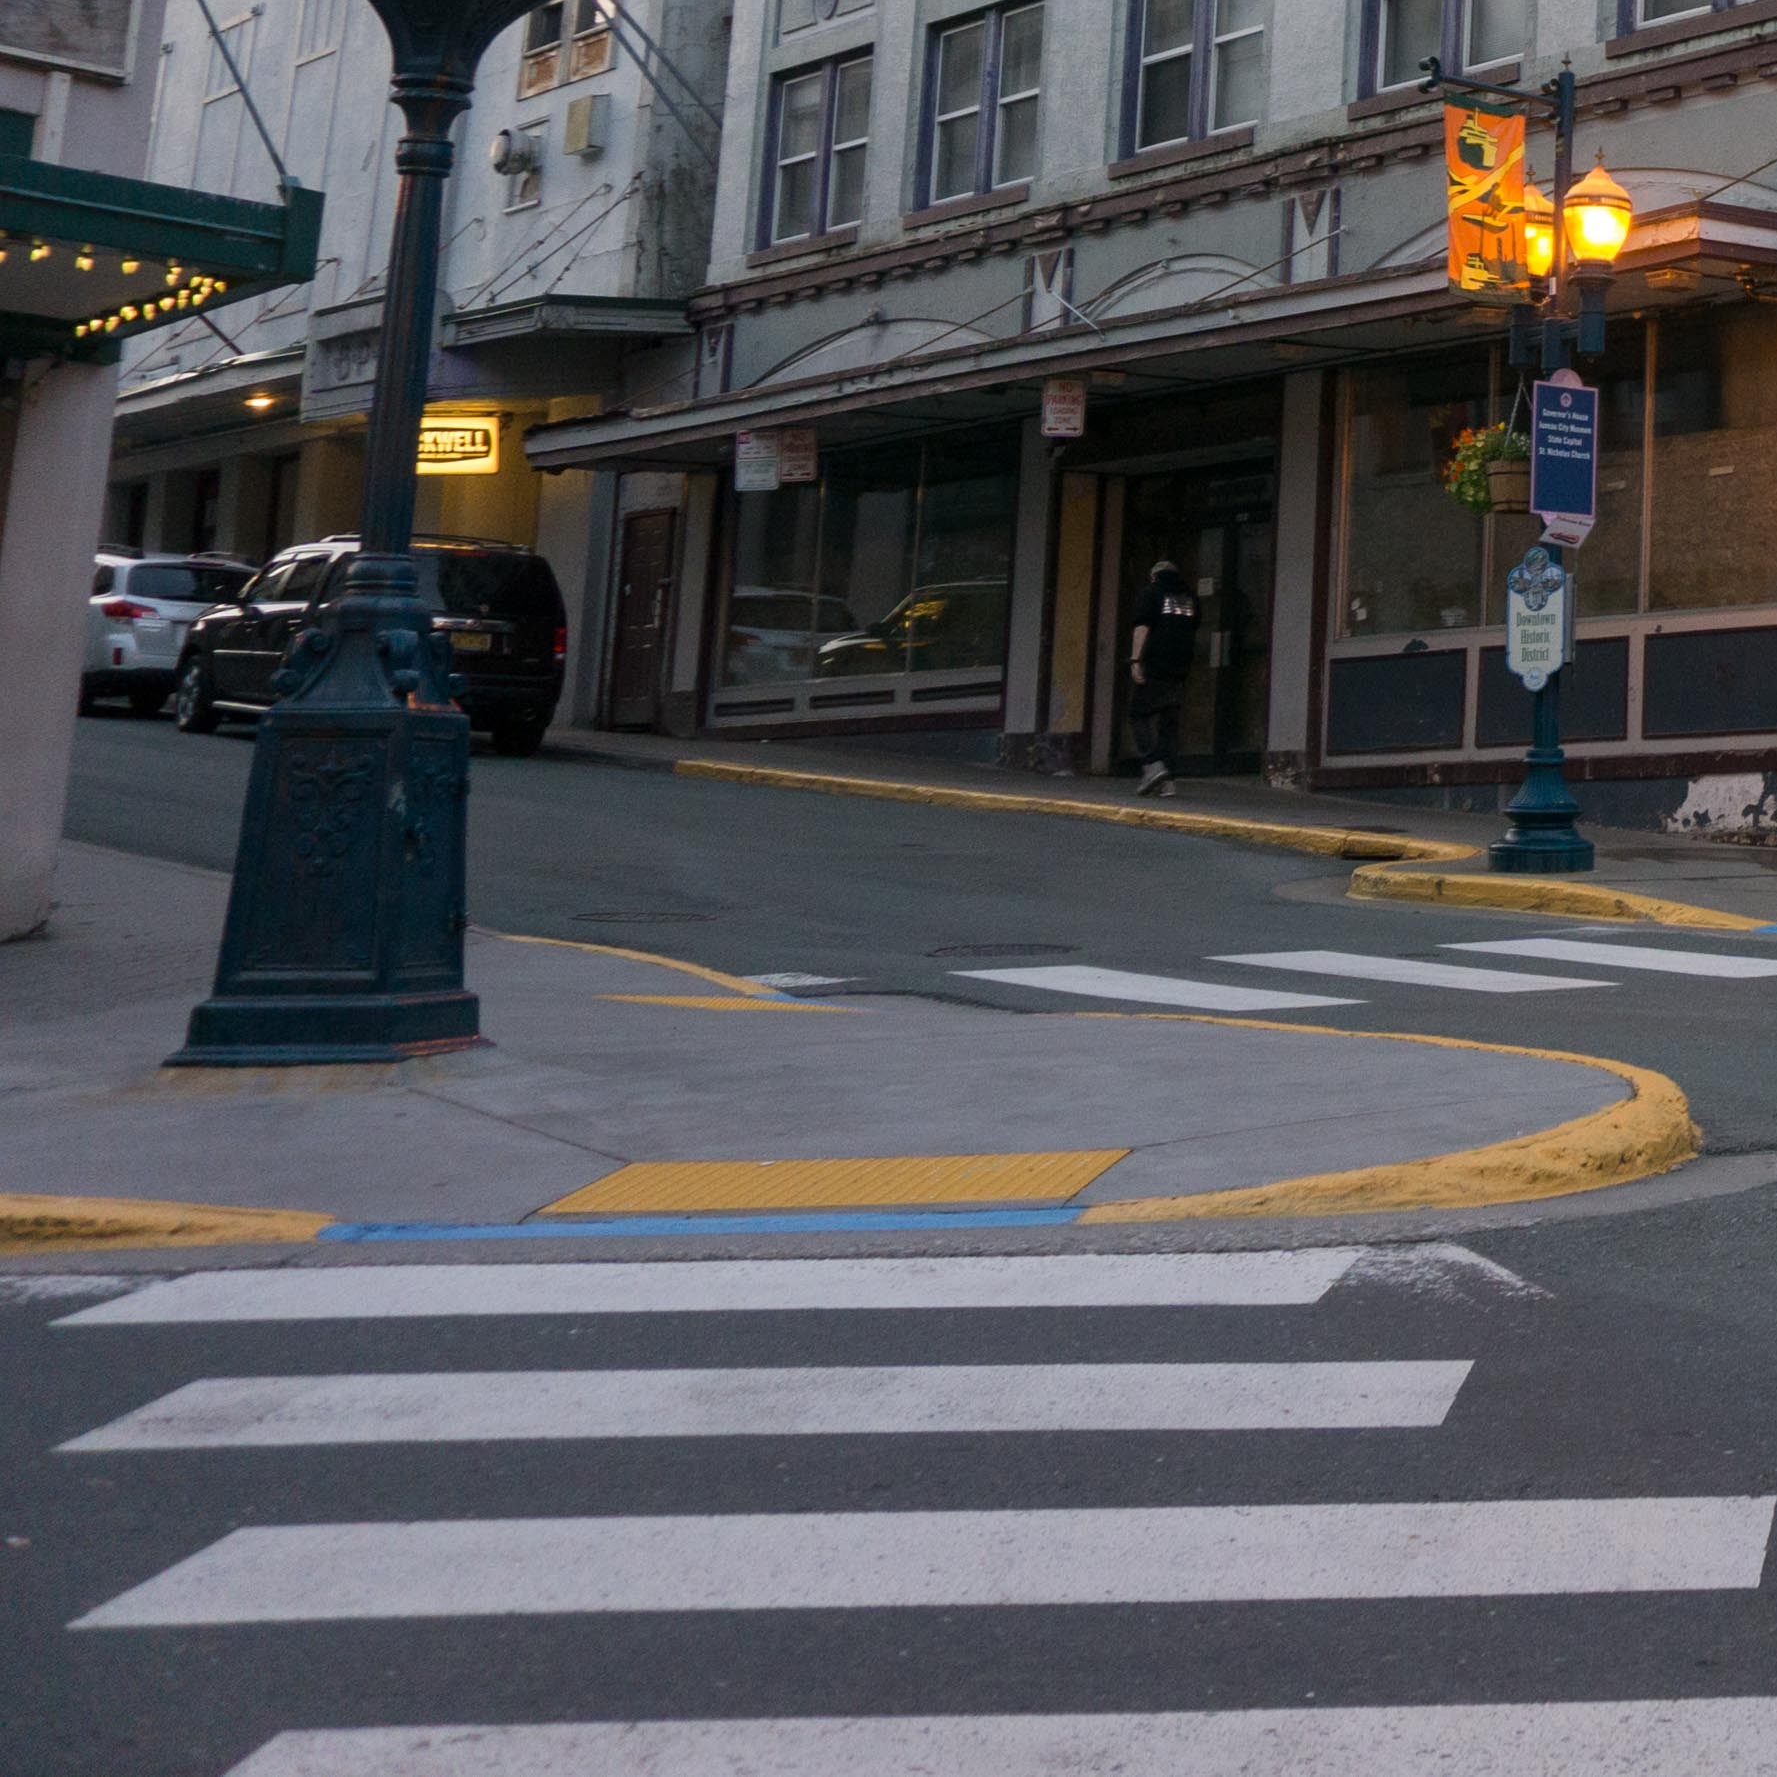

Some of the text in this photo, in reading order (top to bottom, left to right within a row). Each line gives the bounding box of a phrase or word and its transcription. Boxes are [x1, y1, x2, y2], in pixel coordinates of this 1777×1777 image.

[1543, 408, 1571, 419] Governor's
[1558, 423, 1569, 433] City
[1548, 434, 1562, 444] State
[1571, 450, 1590, 460] Church
[1516, 612, 1556, 627] Downtown
[1520, 629, 1550, 644] Historic
[1521, 646, 1549, 662] District
